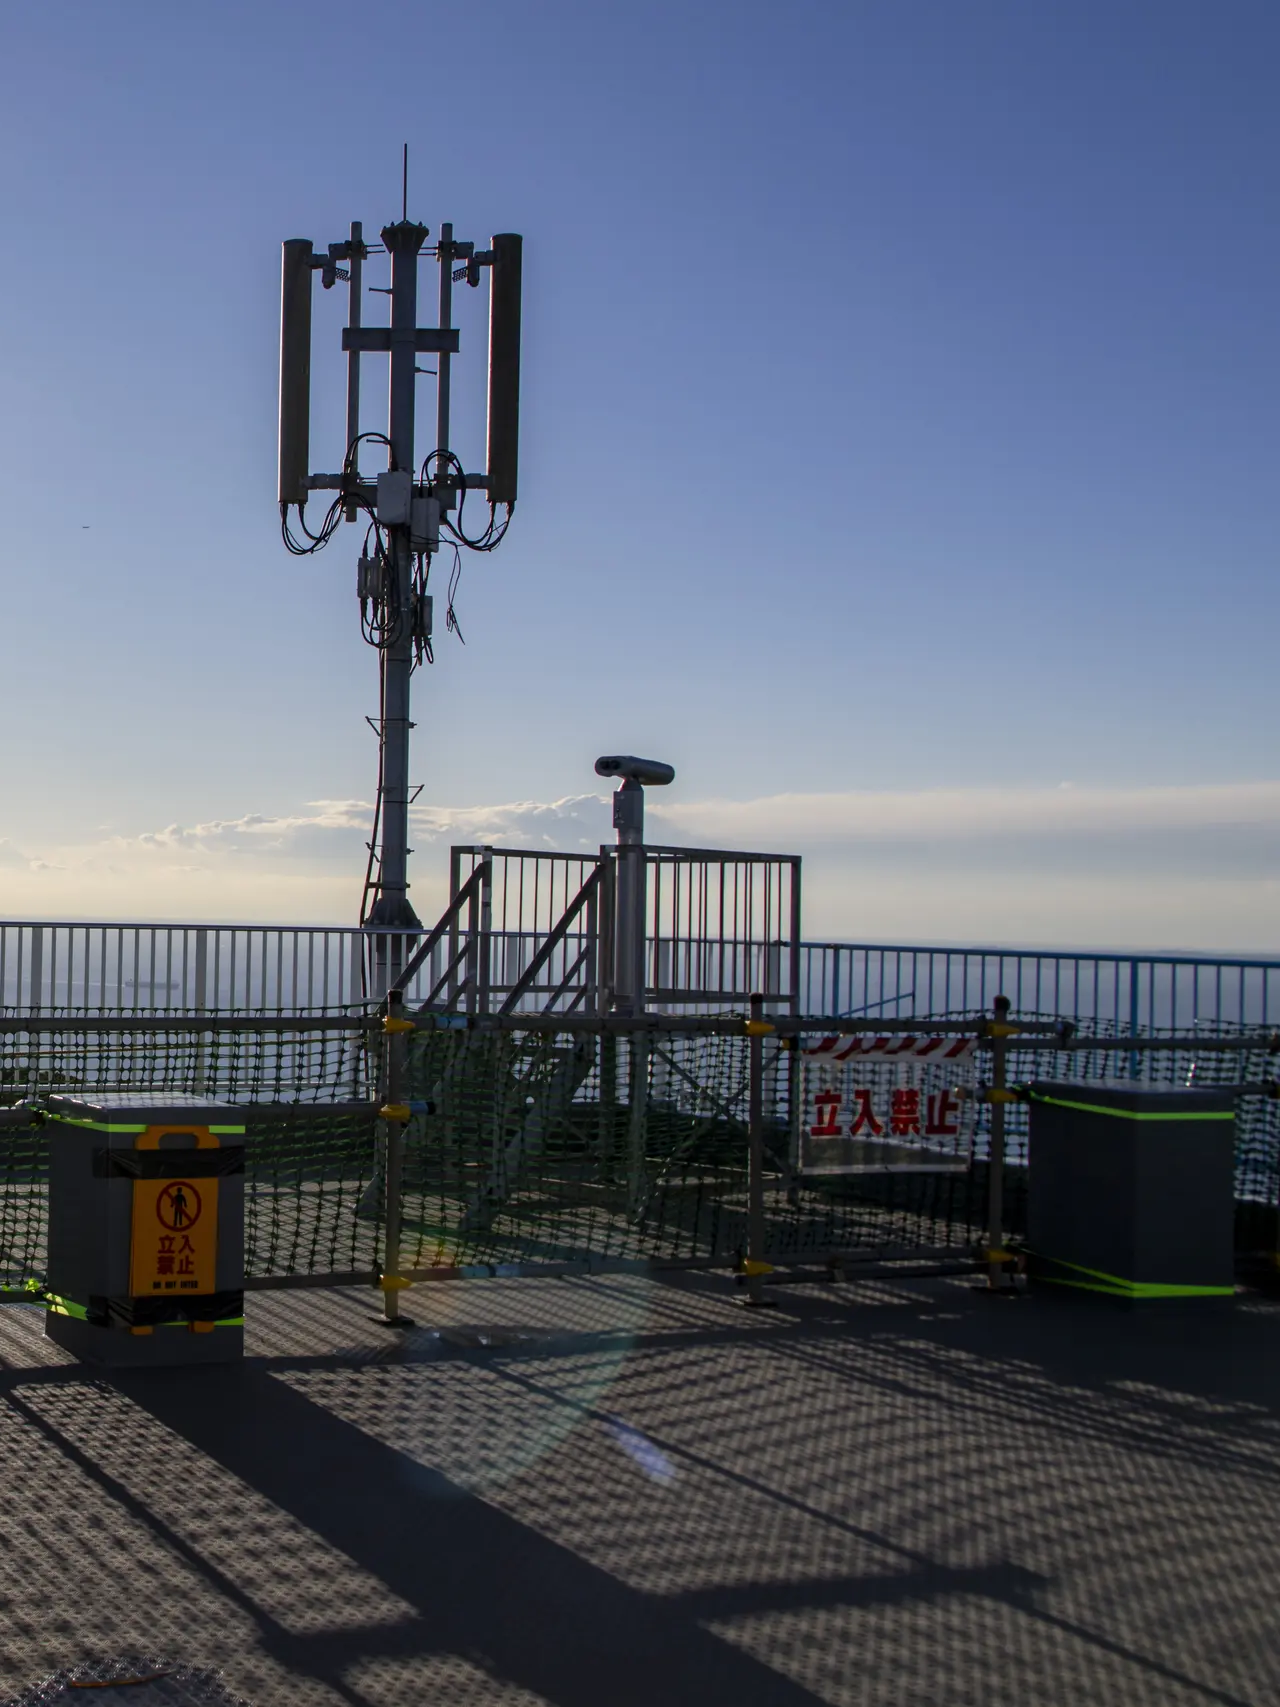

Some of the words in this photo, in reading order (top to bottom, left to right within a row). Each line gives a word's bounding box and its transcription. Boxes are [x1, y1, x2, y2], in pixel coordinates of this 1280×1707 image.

[811, 1089, 959, 1136] 立入禁止
[158, 1234, 195, 1254] 立入
[157, 1255, 194, 1275] 禁止
